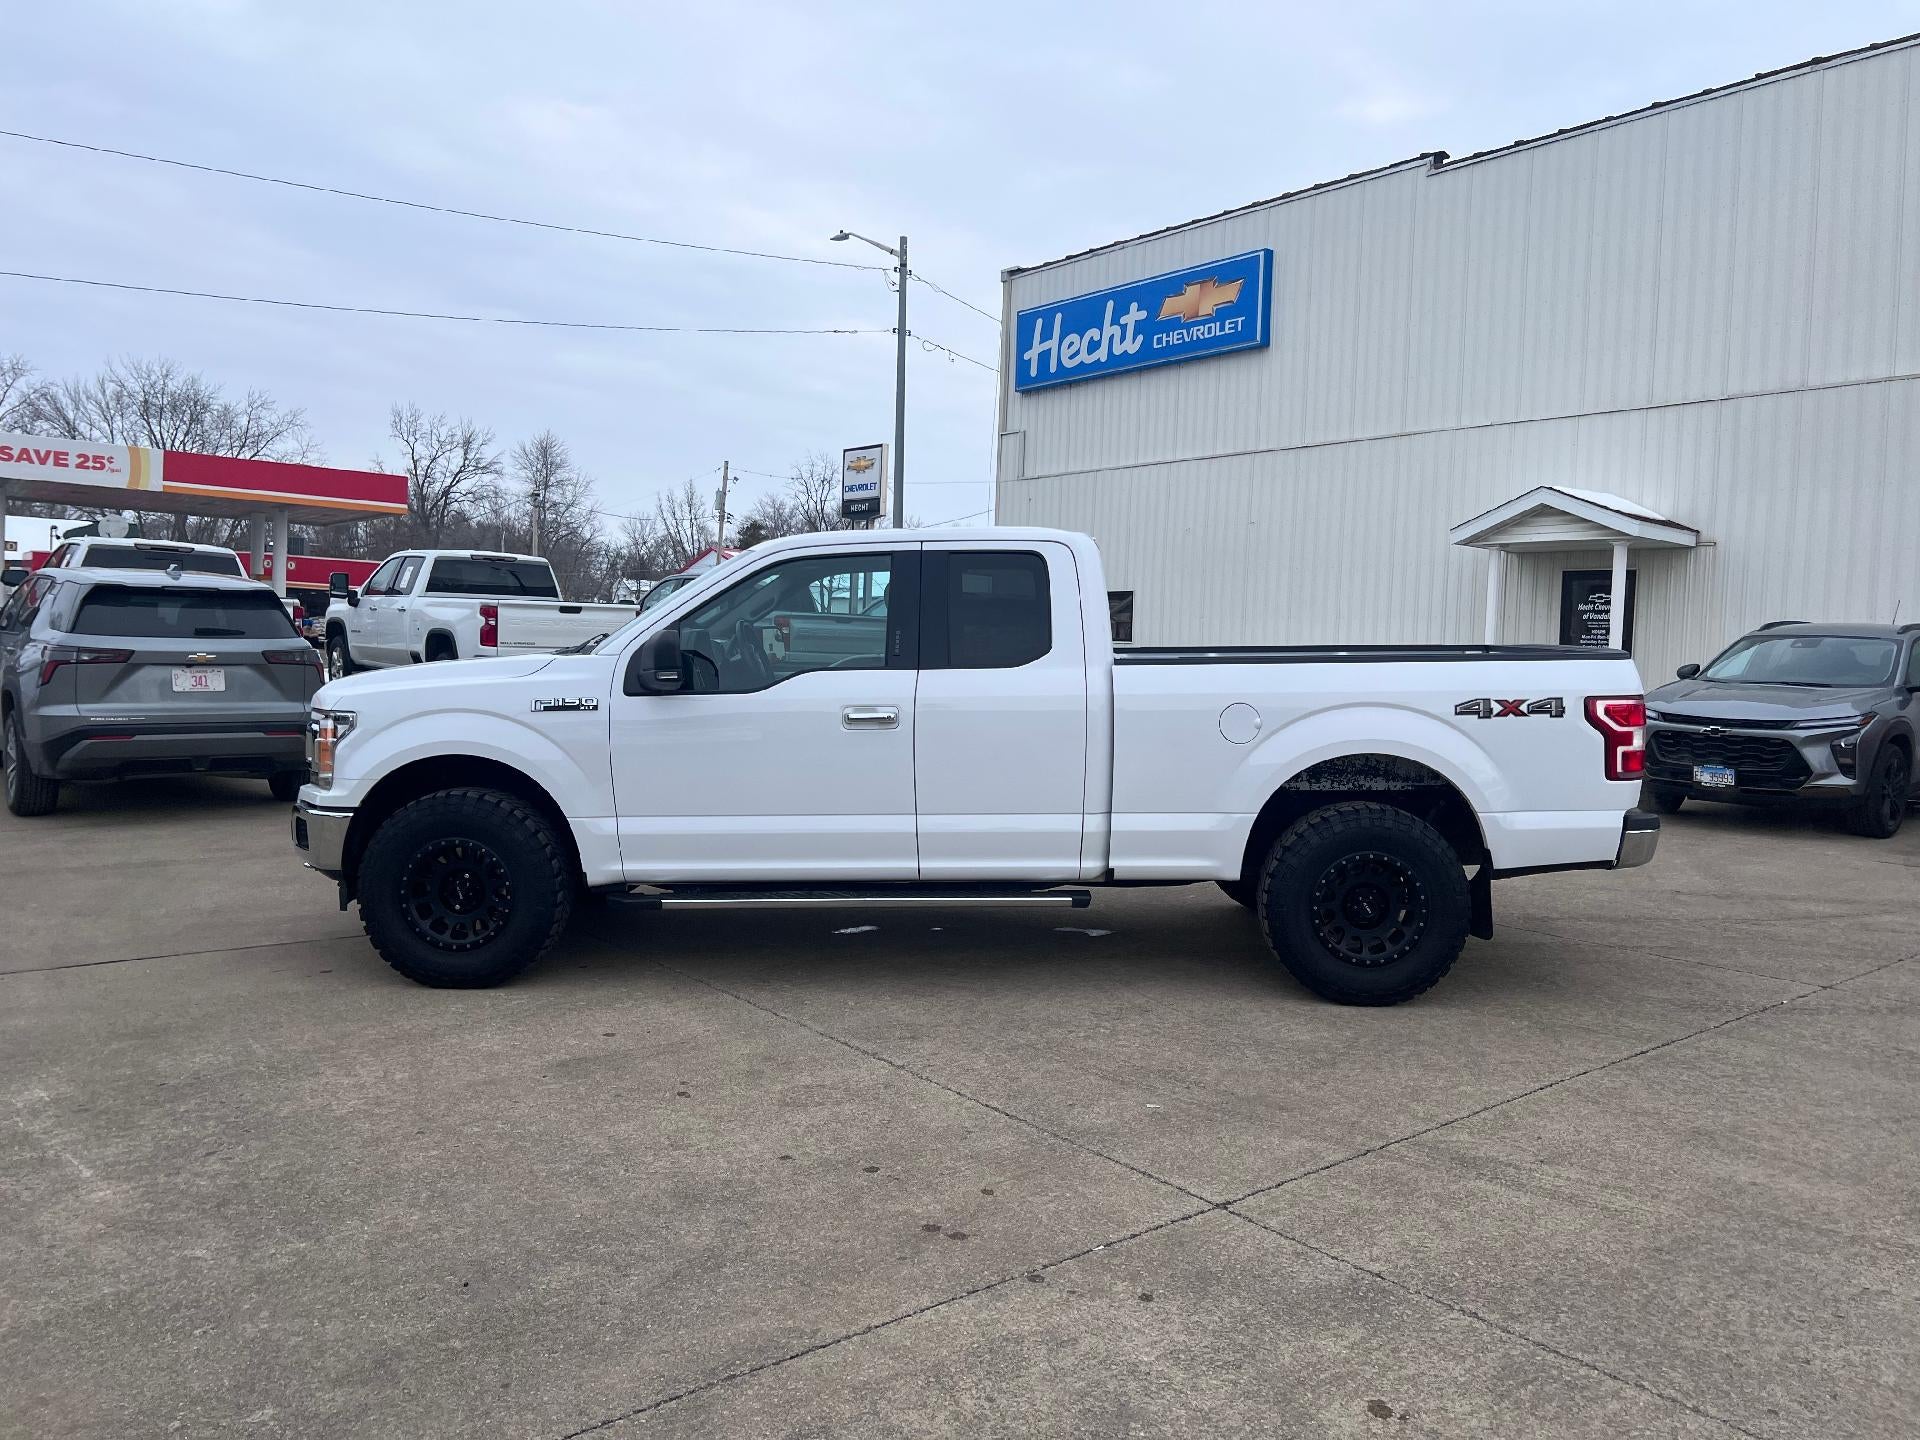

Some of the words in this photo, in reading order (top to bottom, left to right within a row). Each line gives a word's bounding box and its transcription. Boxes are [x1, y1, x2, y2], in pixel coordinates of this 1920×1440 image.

[1024, 300, 1147, 377] Hecht
[1153, 316, 1246, 349] CHEVROLET
[0, 445, 69, 468] SAVE
[844, 482, 877, 493] CHEVROLET
[850, 503, 869, 512] HECHT
[191, 675, 209, 687] 341
